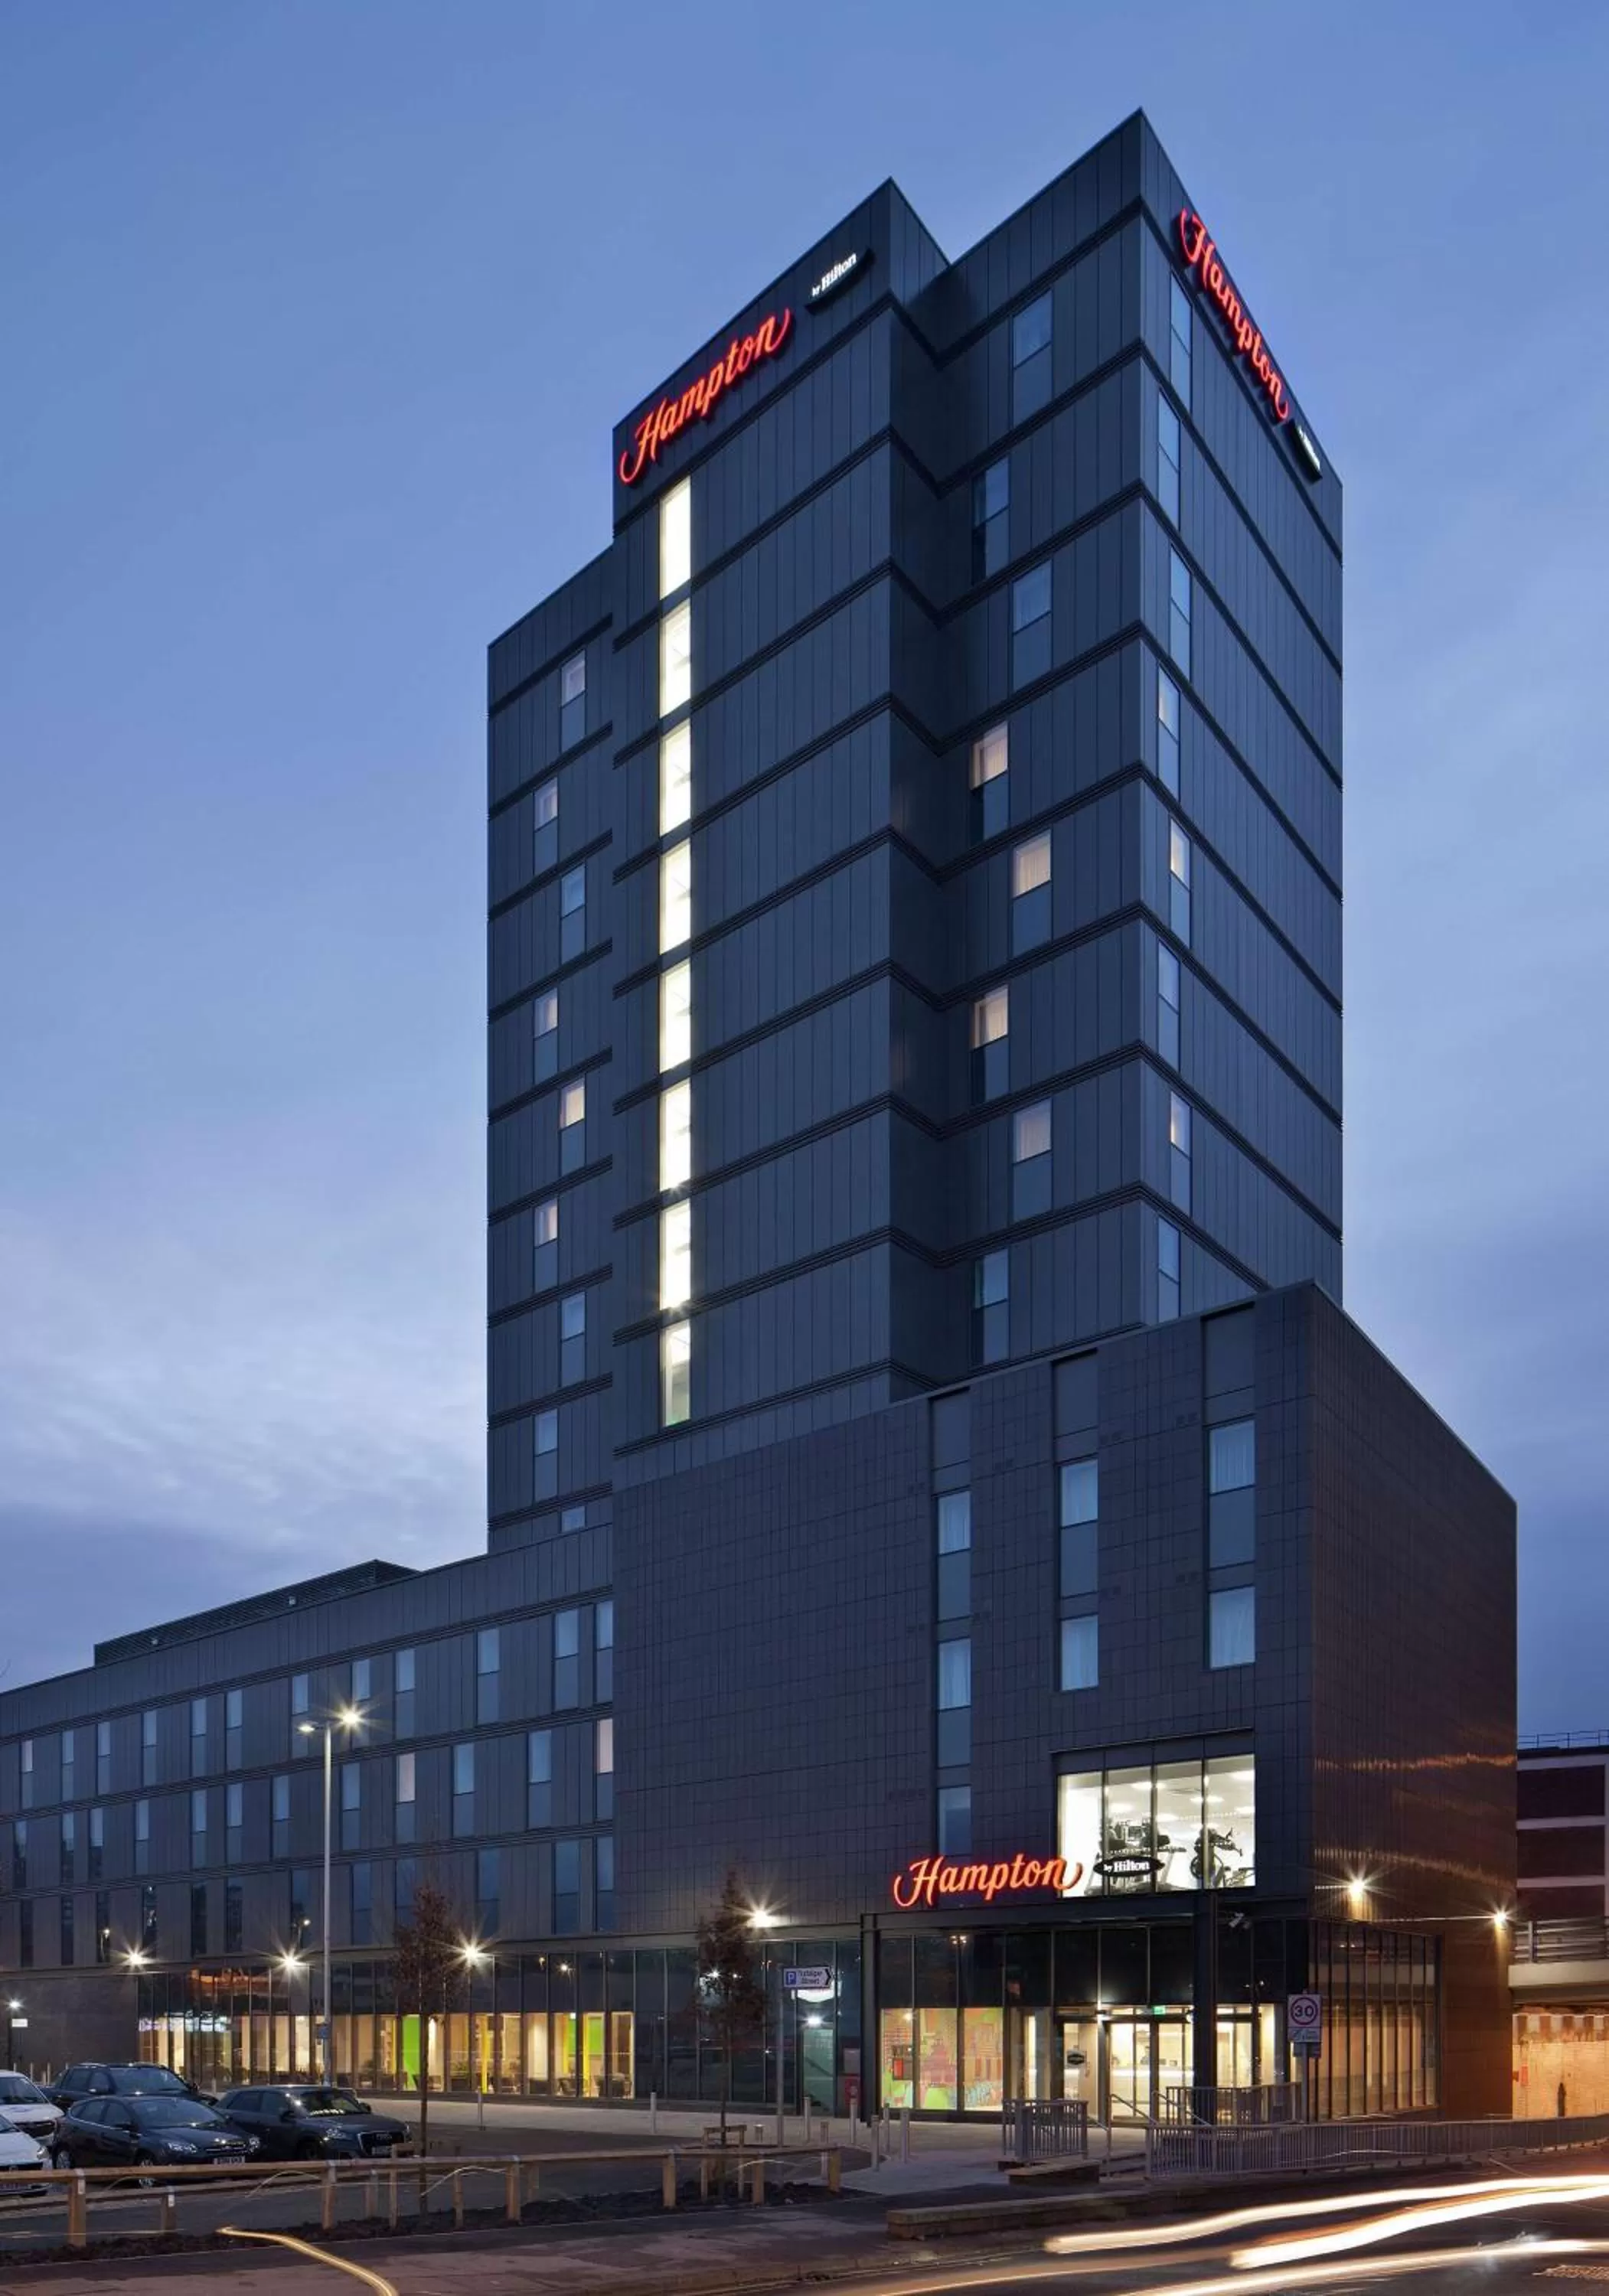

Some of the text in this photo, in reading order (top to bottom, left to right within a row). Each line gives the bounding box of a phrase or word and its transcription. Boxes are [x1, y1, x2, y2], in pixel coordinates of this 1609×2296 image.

[618, 308, 791, 485] Hampton
[821, 253, 857, 292] Hilton
[1180, 208, 1289, 422] Hampton
[893, 1853, 1151, 1907] Hampton by Hilton
[1294, 2005, 1314, 2017] 30
